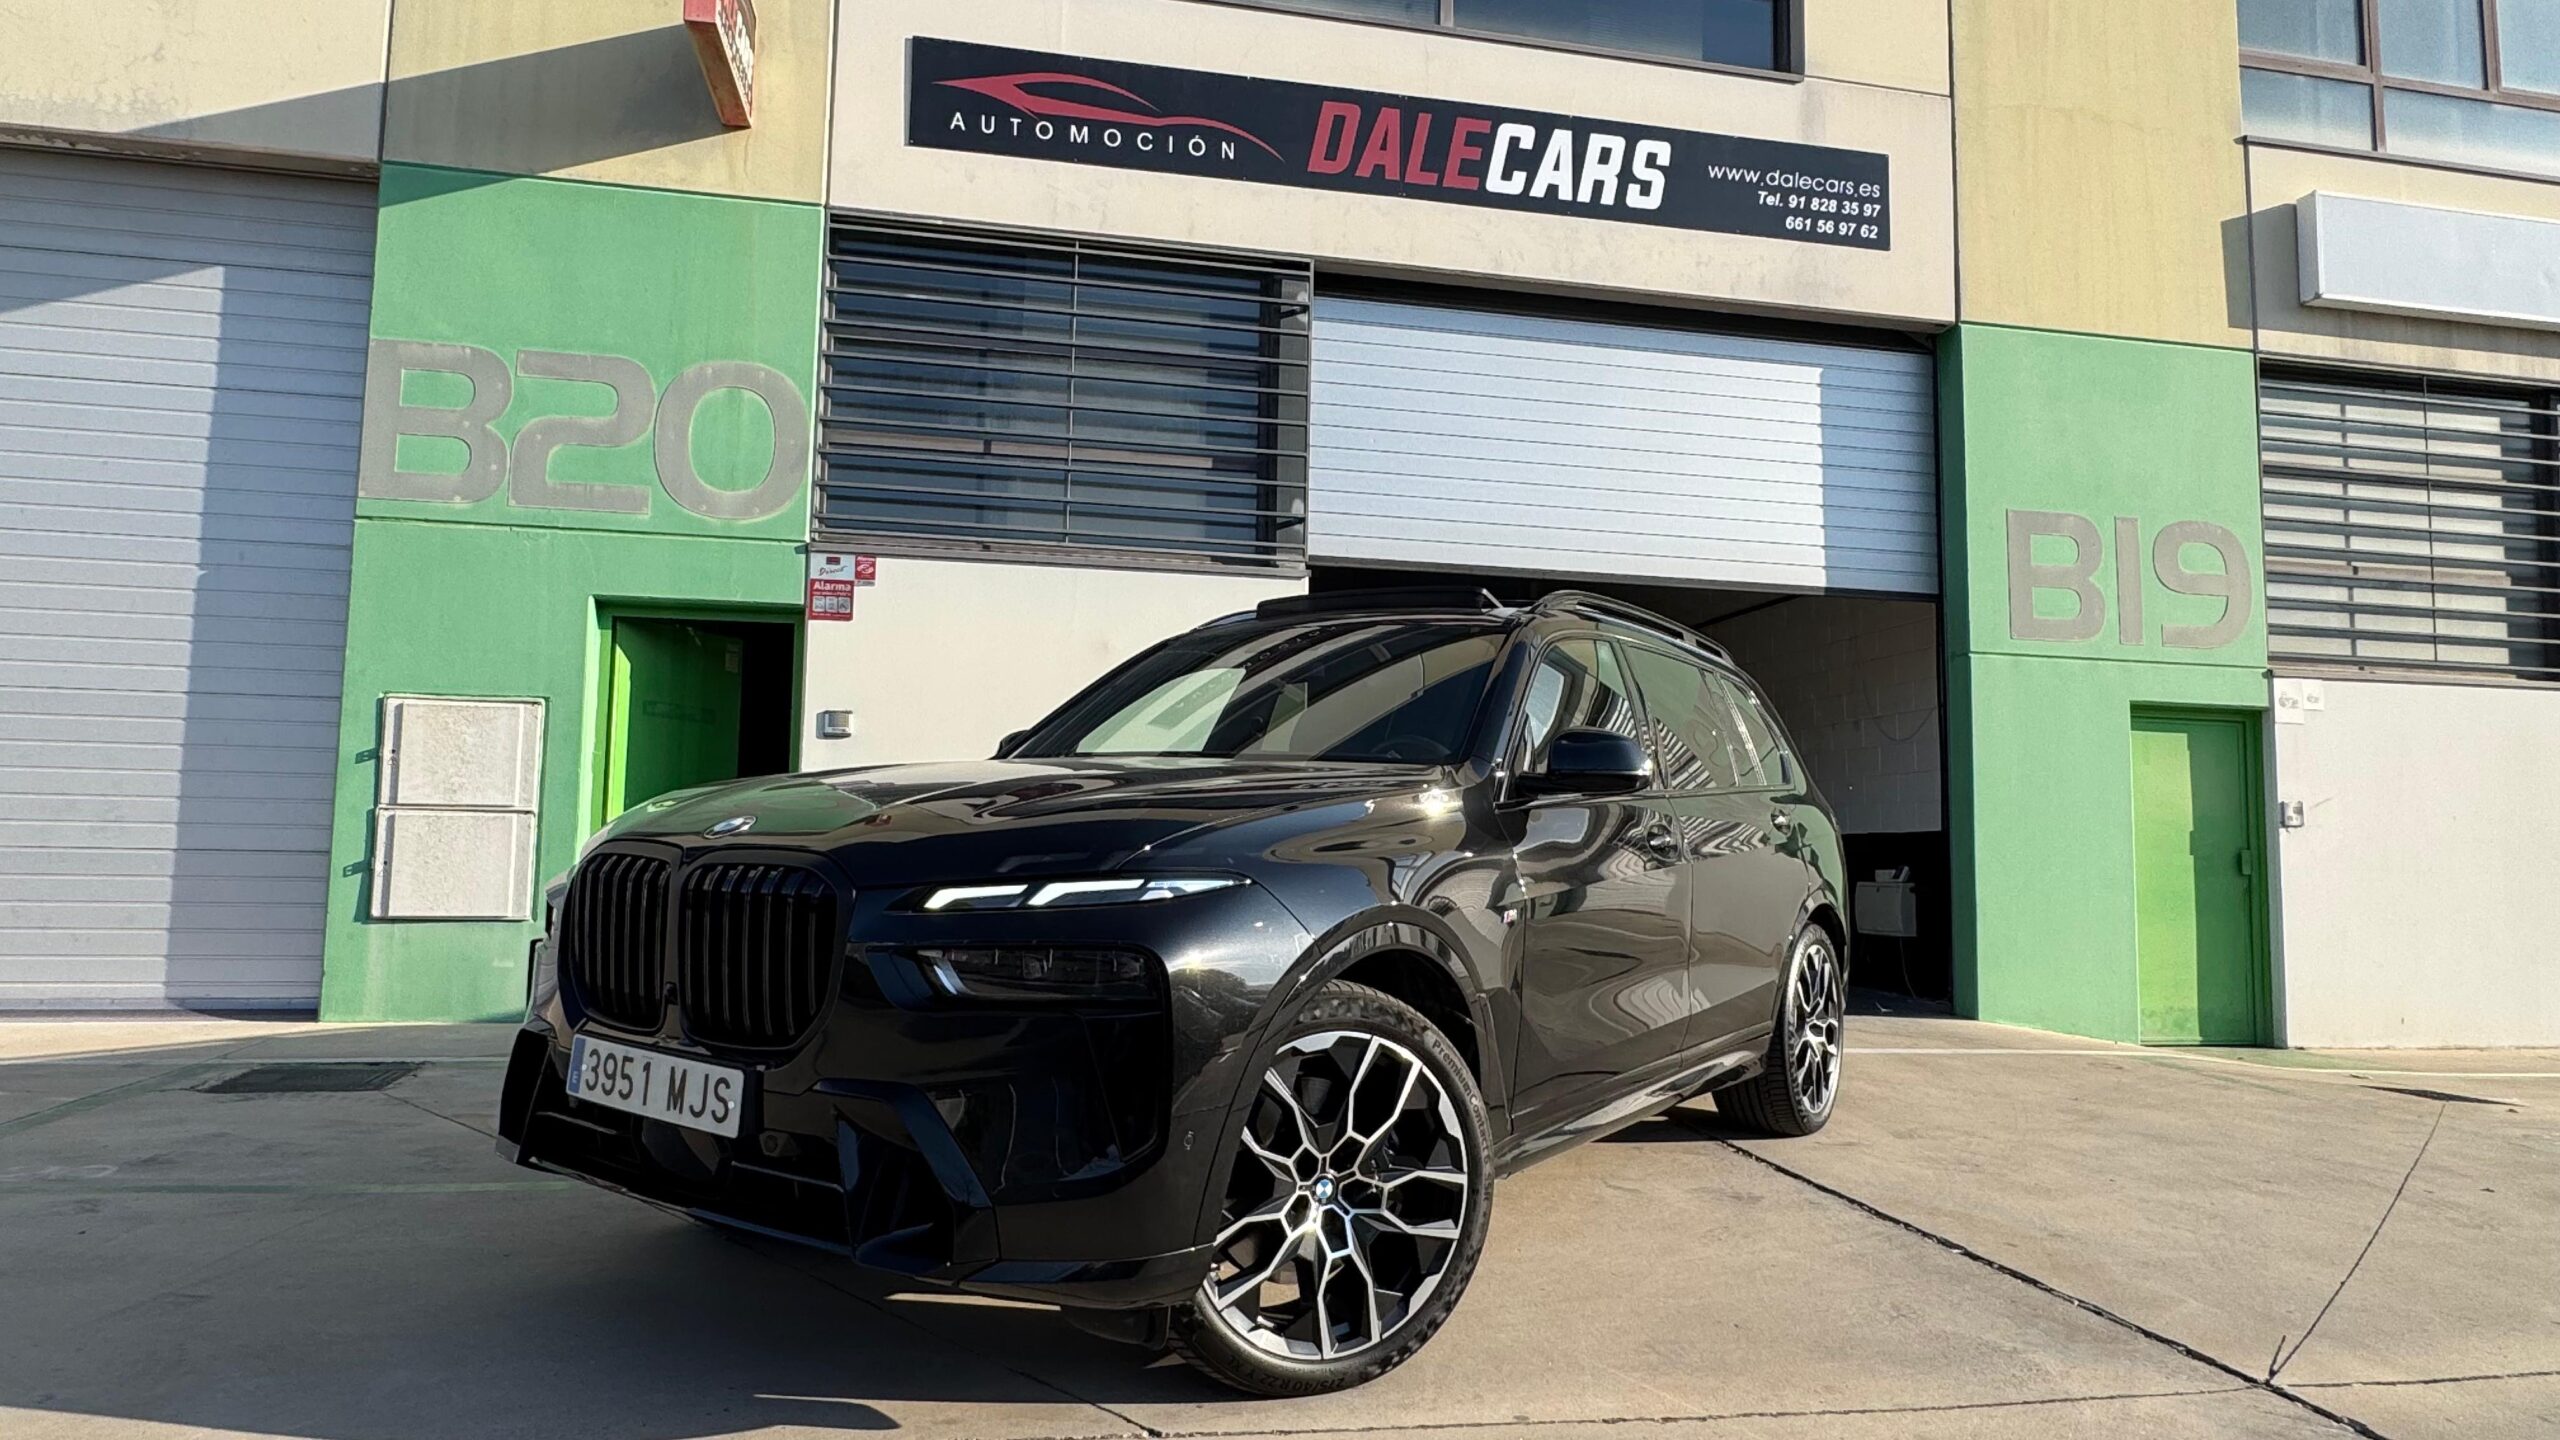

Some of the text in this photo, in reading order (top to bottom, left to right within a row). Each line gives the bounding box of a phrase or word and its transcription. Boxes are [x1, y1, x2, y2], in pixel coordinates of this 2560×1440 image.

[950, 111, 1236, 160] AUTOMOCIÓN
[1307, 101, 1671, 210] DALECARS
[1708, 165, 1881, 198] www.dalecars.es
[1757, 191, 1881, 218] Tel. 91 828 35 97
[1785, 216, 1878, 239] 661 56 97 62
[358, 338, 811, 521] B20
[813, 581, 852, 591] Alarma
[585, 1048, 731, 1123] 3951 MJS
